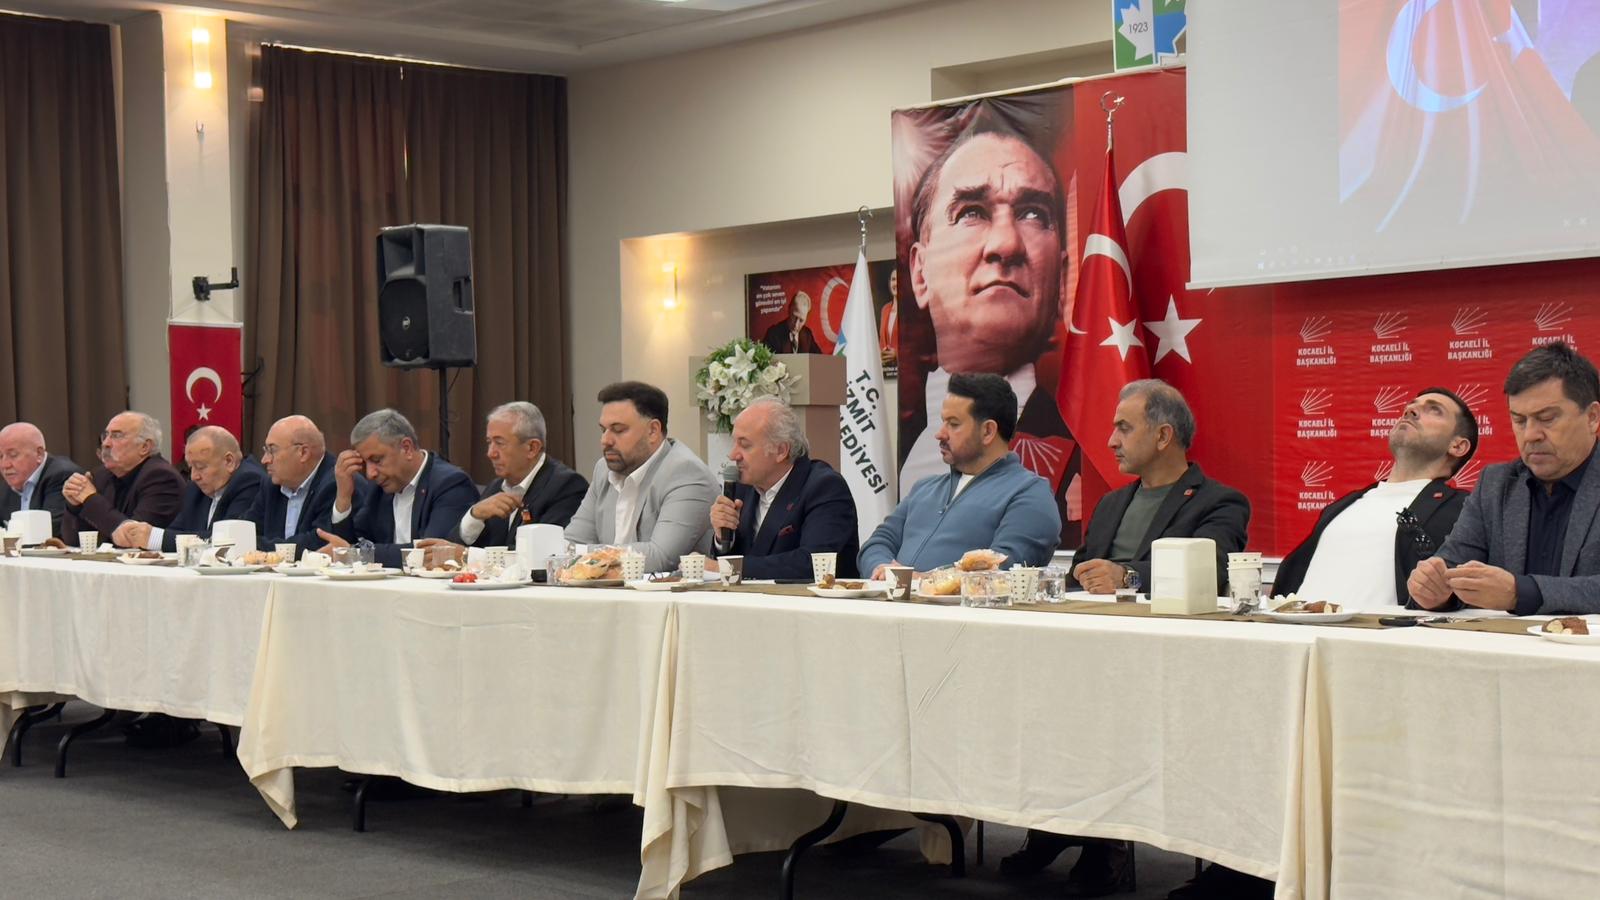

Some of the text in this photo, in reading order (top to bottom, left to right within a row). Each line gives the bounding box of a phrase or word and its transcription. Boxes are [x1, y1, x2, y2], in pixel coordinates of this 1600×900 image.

[1128, 21, 1149, 34] 1923
[1449, 338, 1490, 349] KOCAELİ İL
[1567, 334, 1574, 344] İL
[1298, 346, 1326, 355] KOCAELİ
[1371, 342, 1410, 352] KOCAELİ İL
[1369, 352, 1412, 364] BAŞKANLIĞI
[1448, 349, 1492, 361] BAŞKANLIĞI
[1296, 356, 1336, 367] BAŞKANLIĞI
[855, 369, 880, 410] T.C.
[846, 381, 876, 432] ZMİT
[1298, 418, 1334, 427] KOCAELİ İL
[1296, 428, 1337, 439] BAŞKANLIĞI
[839, 416, 889, 494] EDİYESİ
[1299, 490, 1336, 500] KOCAELİ İL
